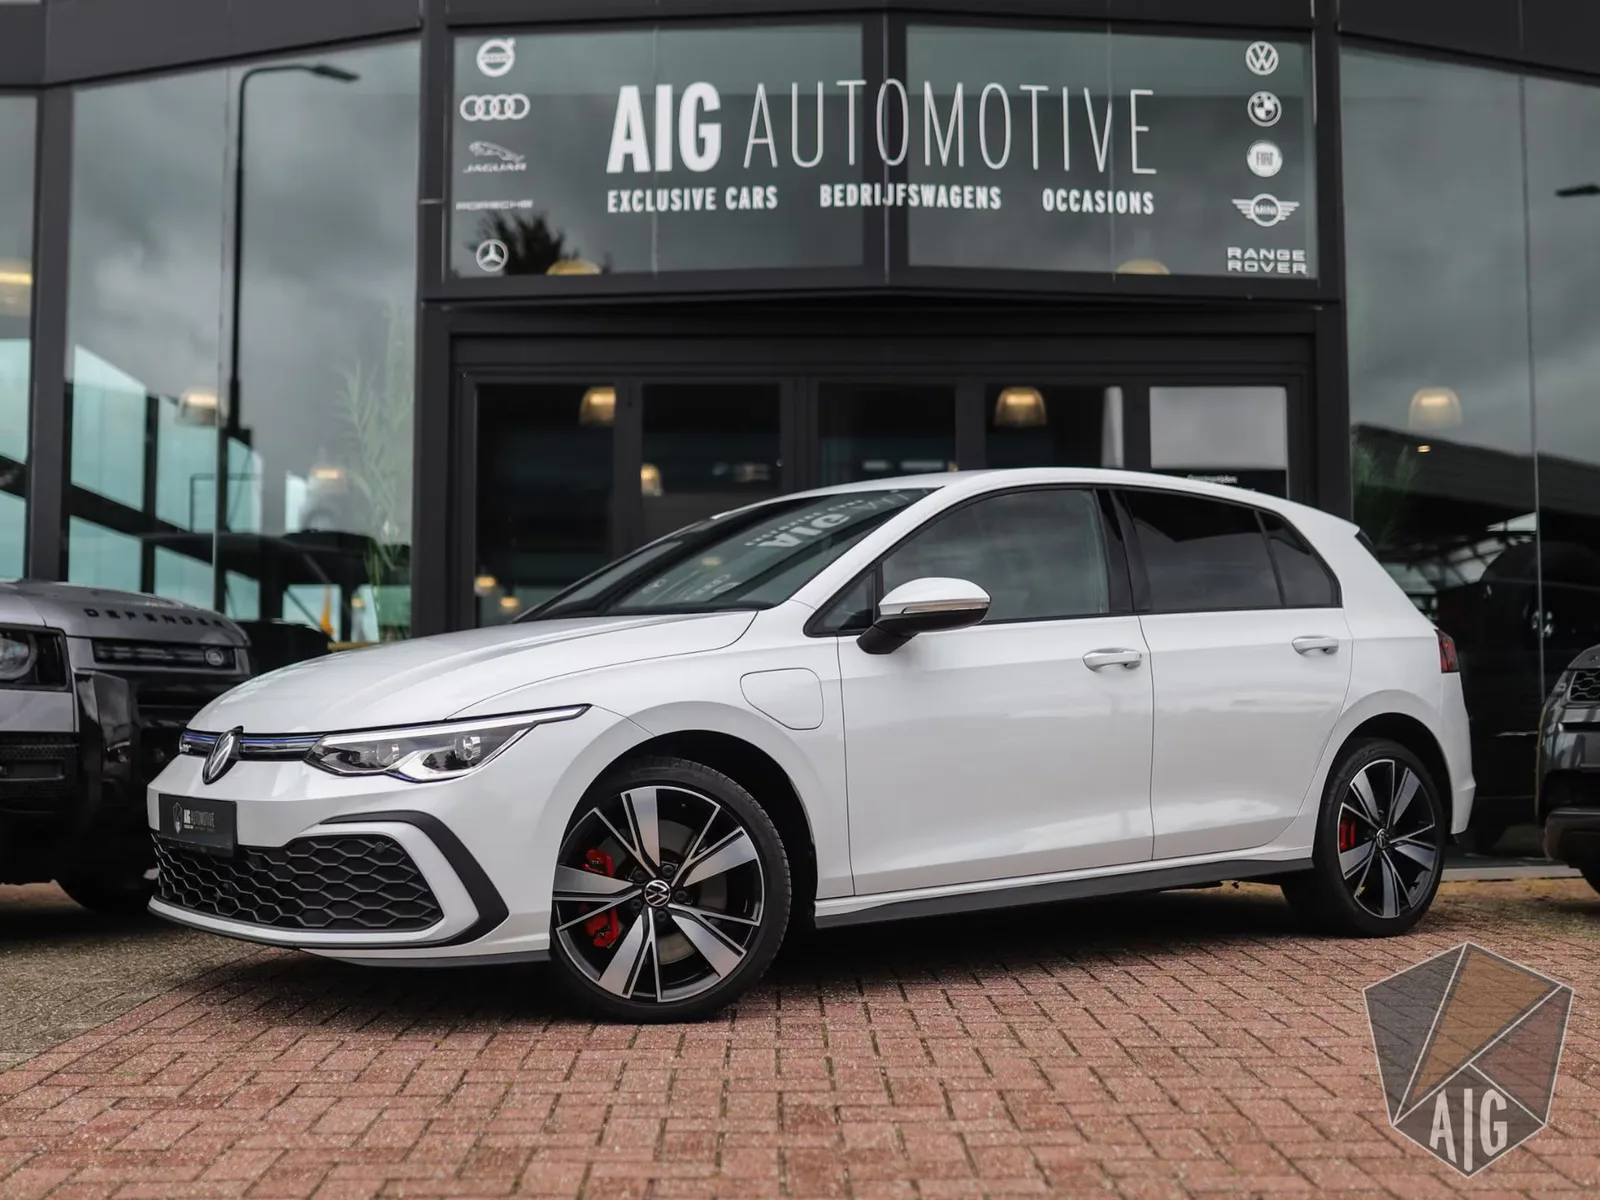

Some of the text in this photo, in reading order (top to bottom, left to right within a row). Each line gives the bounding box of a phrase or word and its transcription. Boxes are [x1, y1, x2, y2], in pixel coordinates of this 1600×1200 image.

[606, 78, 1157, 174] AIG AUTOMOTIVE
[607, 183, 1155, 214] EXCLUSIVE CARS BEDRIJFSWAGENS OCCASIONS
[1227, 246, 1306, 261] RANGE
[1227, 260, 1308, 275] ROVER
[83, 607, 224, 628] DEFENDER
